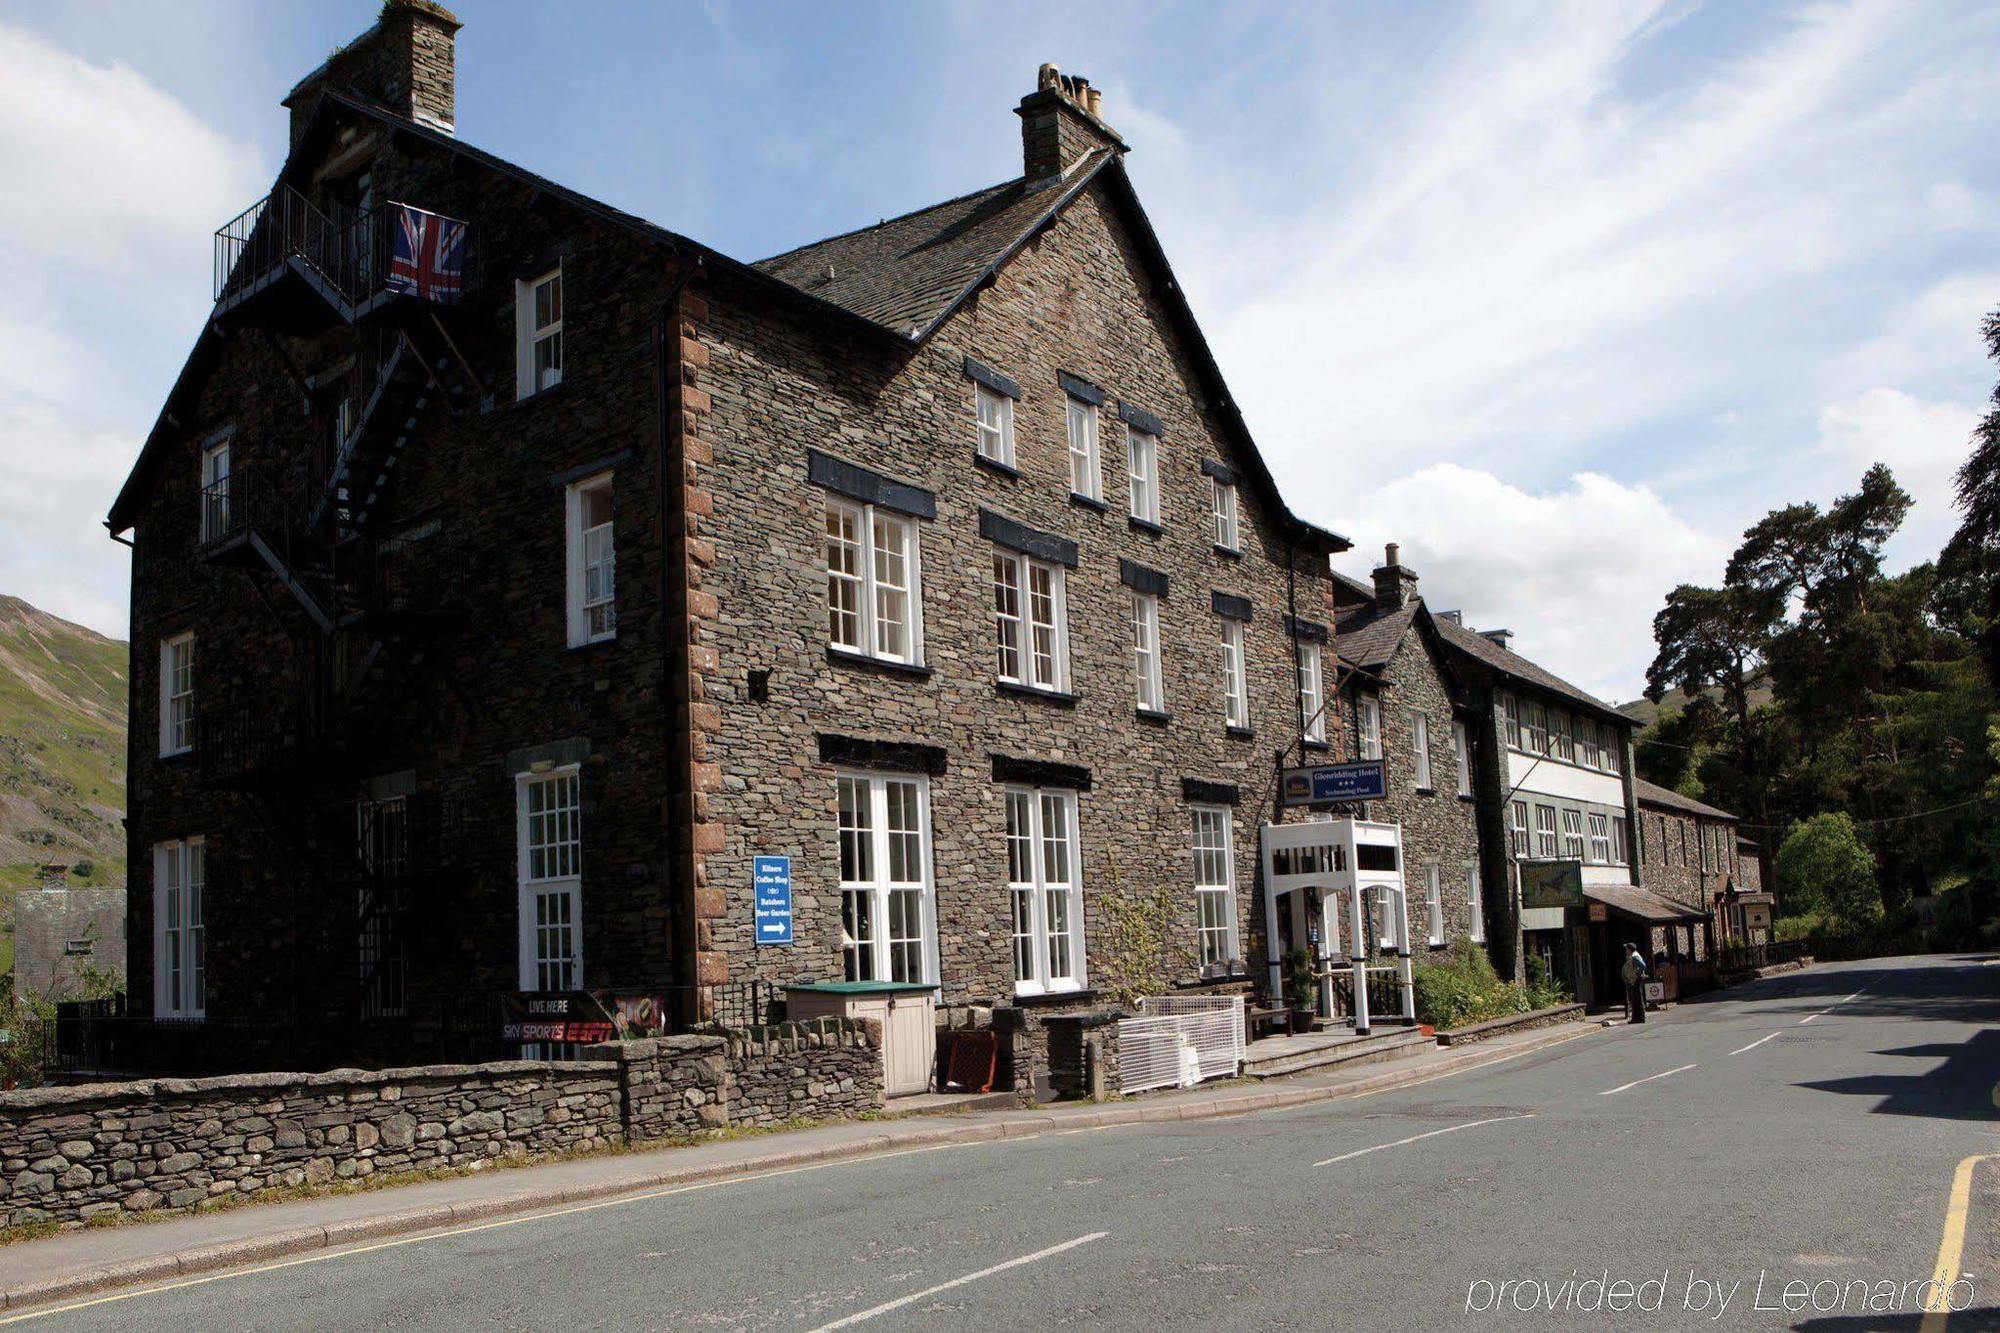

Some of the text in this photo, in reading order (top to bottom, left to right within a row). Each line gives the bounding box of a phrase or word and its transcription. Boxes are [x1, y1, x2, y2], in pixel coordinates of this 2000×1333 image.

[1358, 767, 1379, 777] Hotel
[1357, 786, 1369, 794] Pool
[756, 876, 788, 885] Coffee Shop
[529, 1000, 568, 1013] LIVE HERE
[504, 1022, 613, 1041] SKY SPORTS ESPN
